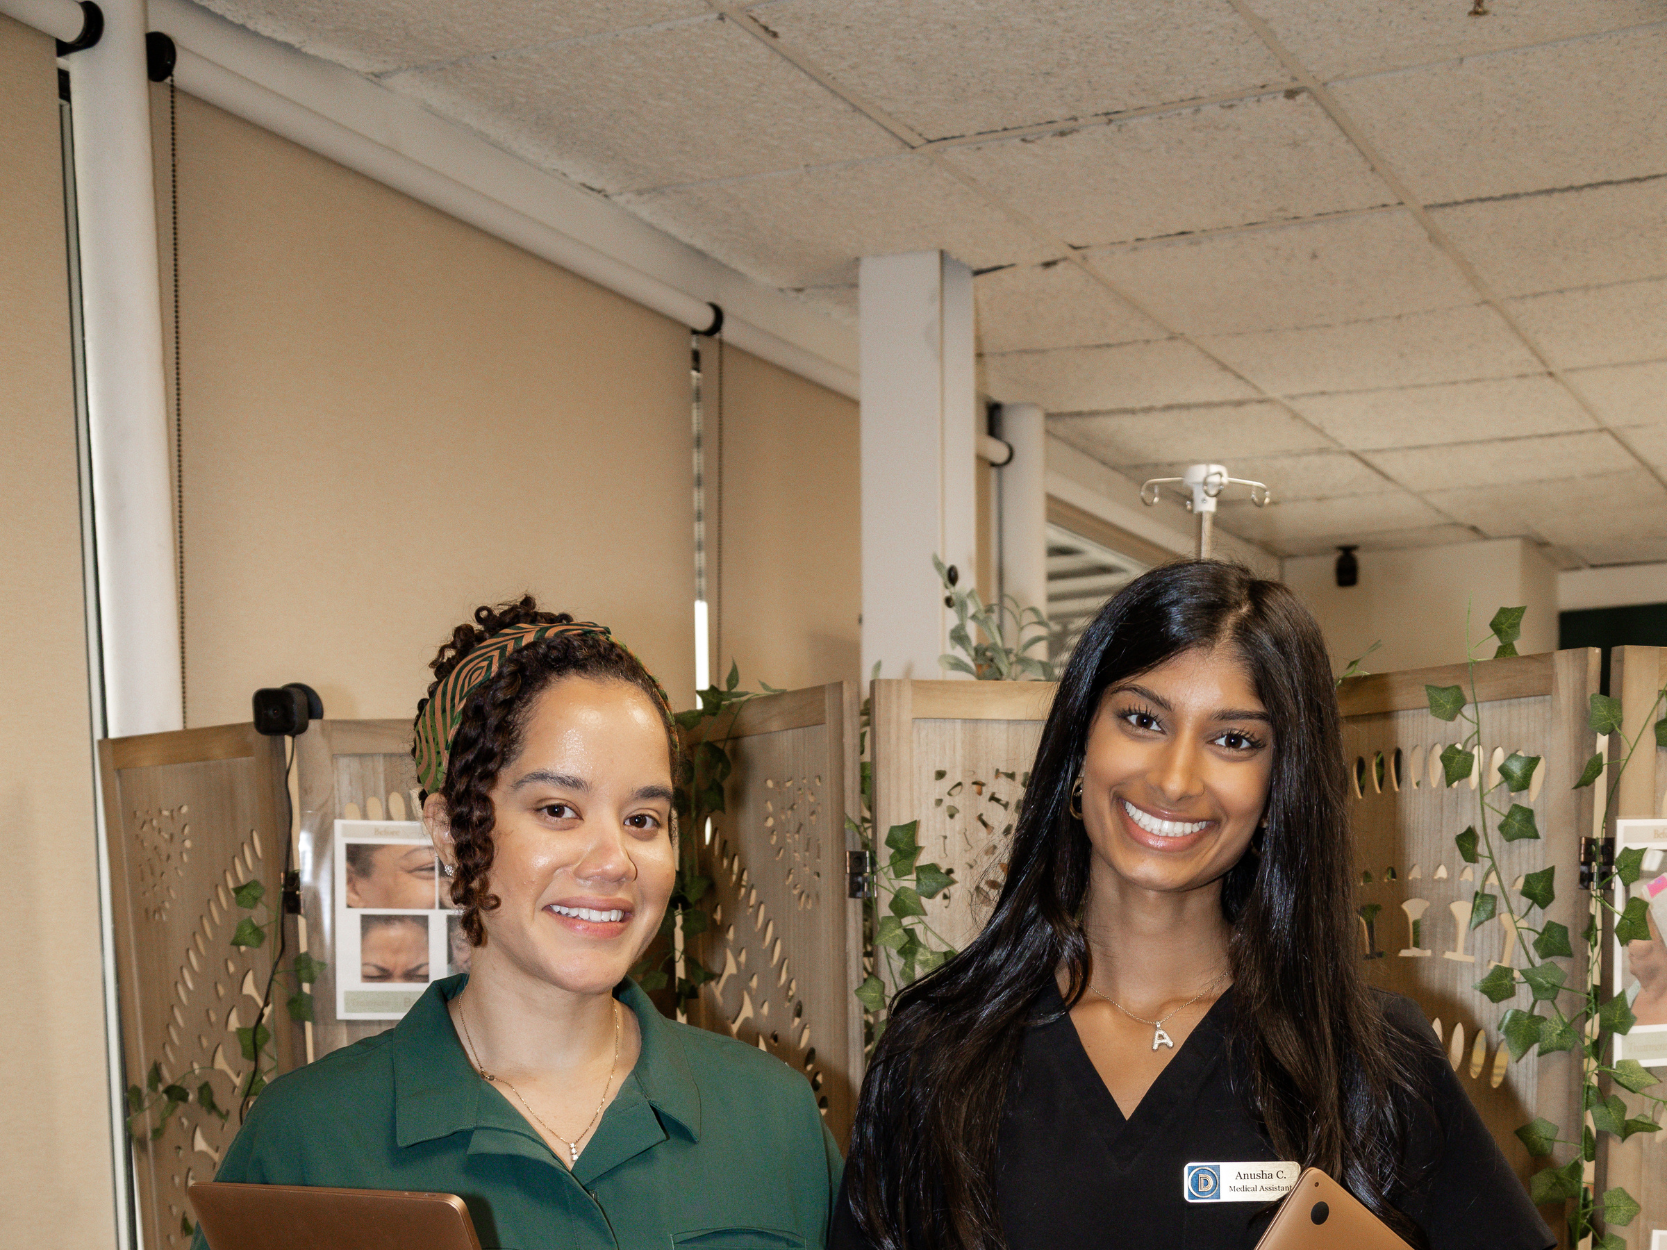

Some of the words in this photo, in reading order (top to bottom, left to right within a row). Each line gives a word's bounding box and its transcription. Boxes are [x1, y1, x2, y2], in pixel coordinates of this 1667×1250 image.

[1235, 1170, 1273, 1180] Anusha
[1276, 1170, 1287, 1180] C.
[1260, 1184, 1292, 1192] Assistant
